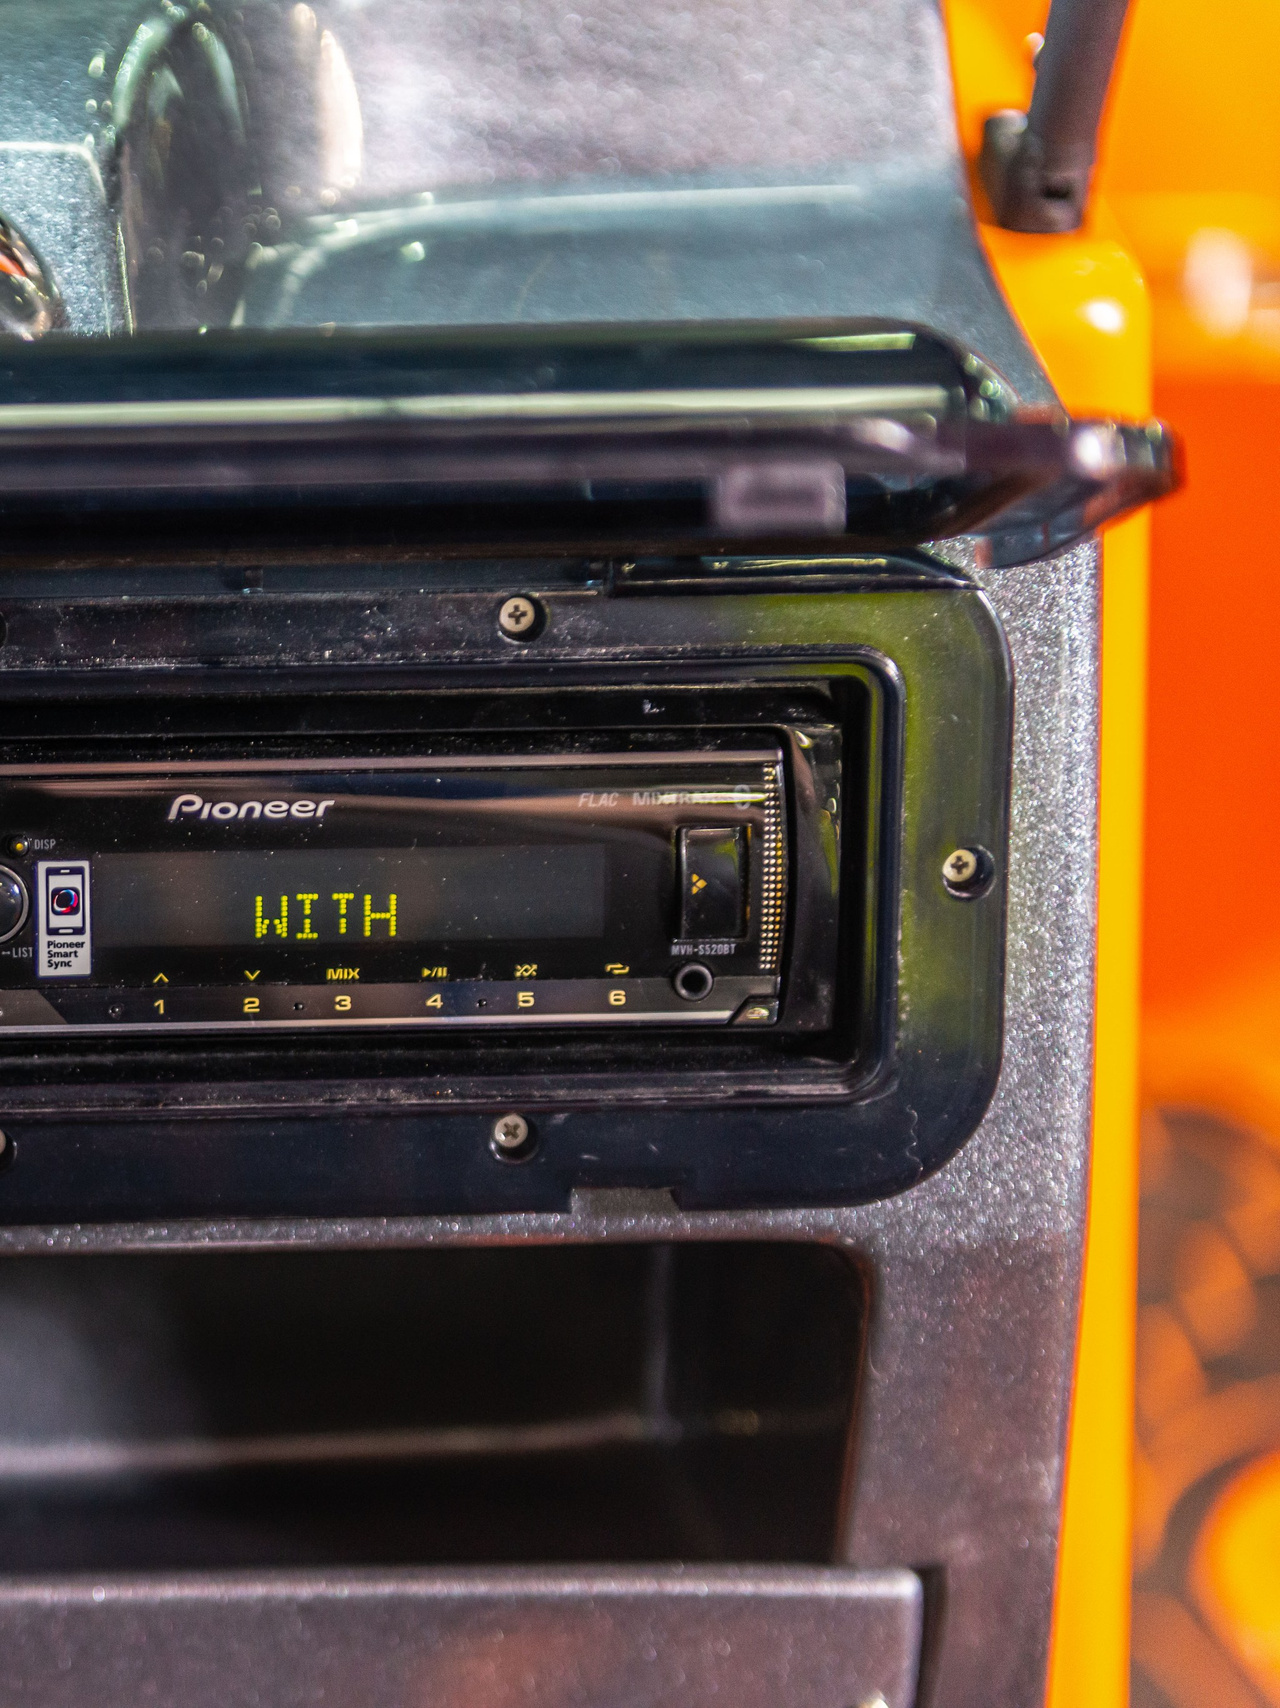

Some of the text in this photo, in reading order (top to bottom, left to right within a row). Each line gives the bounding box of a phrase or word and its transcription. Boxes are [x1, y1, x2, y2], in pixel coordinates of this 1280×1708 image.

[168, 794, 335, 820] Pioneer
[578, 792, 620, 808] FLAC
[34, 839, 56, 850] DISP
[255, 893, 397, 939] WITH
[47, 940, 85, 949] Pioneer
[670, 943, 737, 956] MVH-S520BT
[12, 947, 34, 958] LIST
[47, 950, 79, 958] Smart
[47, 959, 73, 969] Sync
[326, 967, 360, 981] MIX
[243, 998, 260, 1013] 2
[334, 995, 352, 1011] 3
[425, 993, 444, 1010] 4
[517, 992, 535, 1007] 5
[608, 990, 626, 1006] 6
[153, 999, 165, 1014] 1
